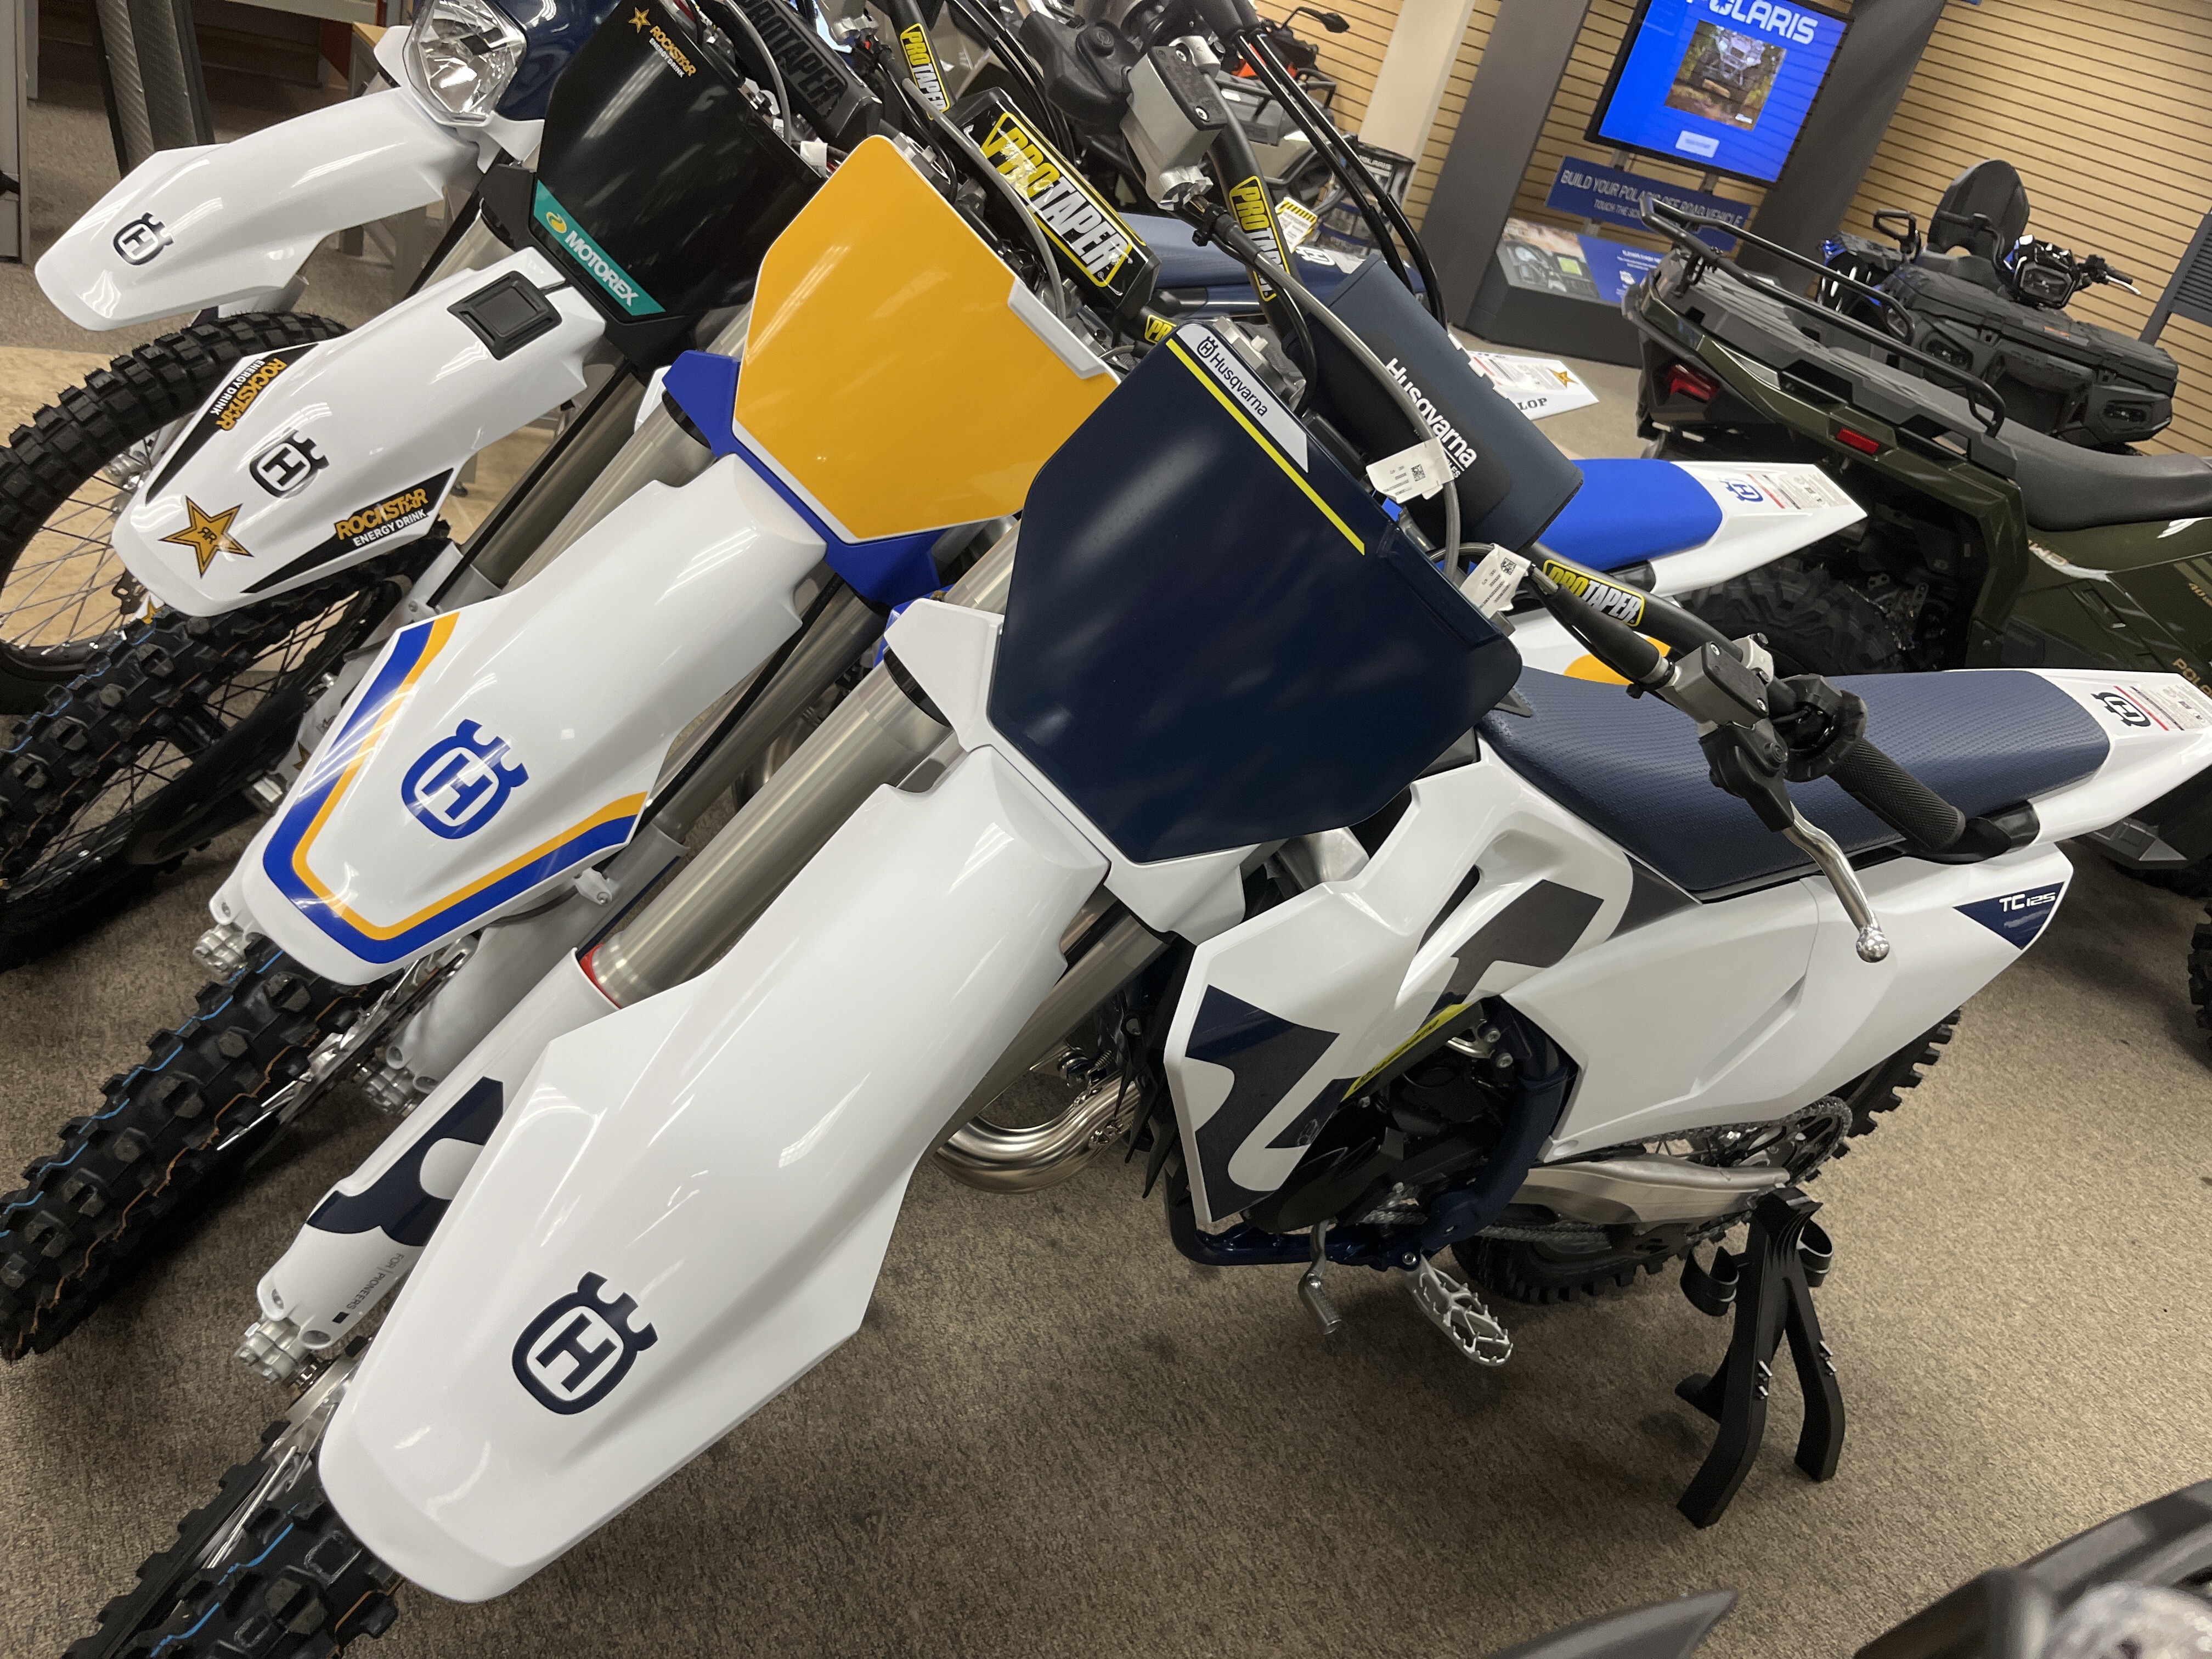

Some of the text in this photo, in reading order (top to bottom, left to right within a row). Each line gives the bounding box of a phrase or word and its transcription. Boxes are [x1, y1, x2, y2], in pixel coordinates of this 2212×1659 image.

[1686, 0, 1818, 44] OLARIS
[650, 26, 696, 76] ROCKSTAR
[1561, 170, 1593, 189] BUILD
[1593, 178, 1620, 196] YOUR
[565, 230, 639, 307] MOTOREX
[210, 359, 266, 415] ENERGY DRINK
[216, 358, 287, 430] ROCKSTAR
[1210, 353, 1268, 416] Husqvarna
[336, 488, 428, 540] ROCKSTAR
[353, 509, 427, 546] ENERGY DRINK
[346, 1253, 405, 1310] FOR PIONEERS
